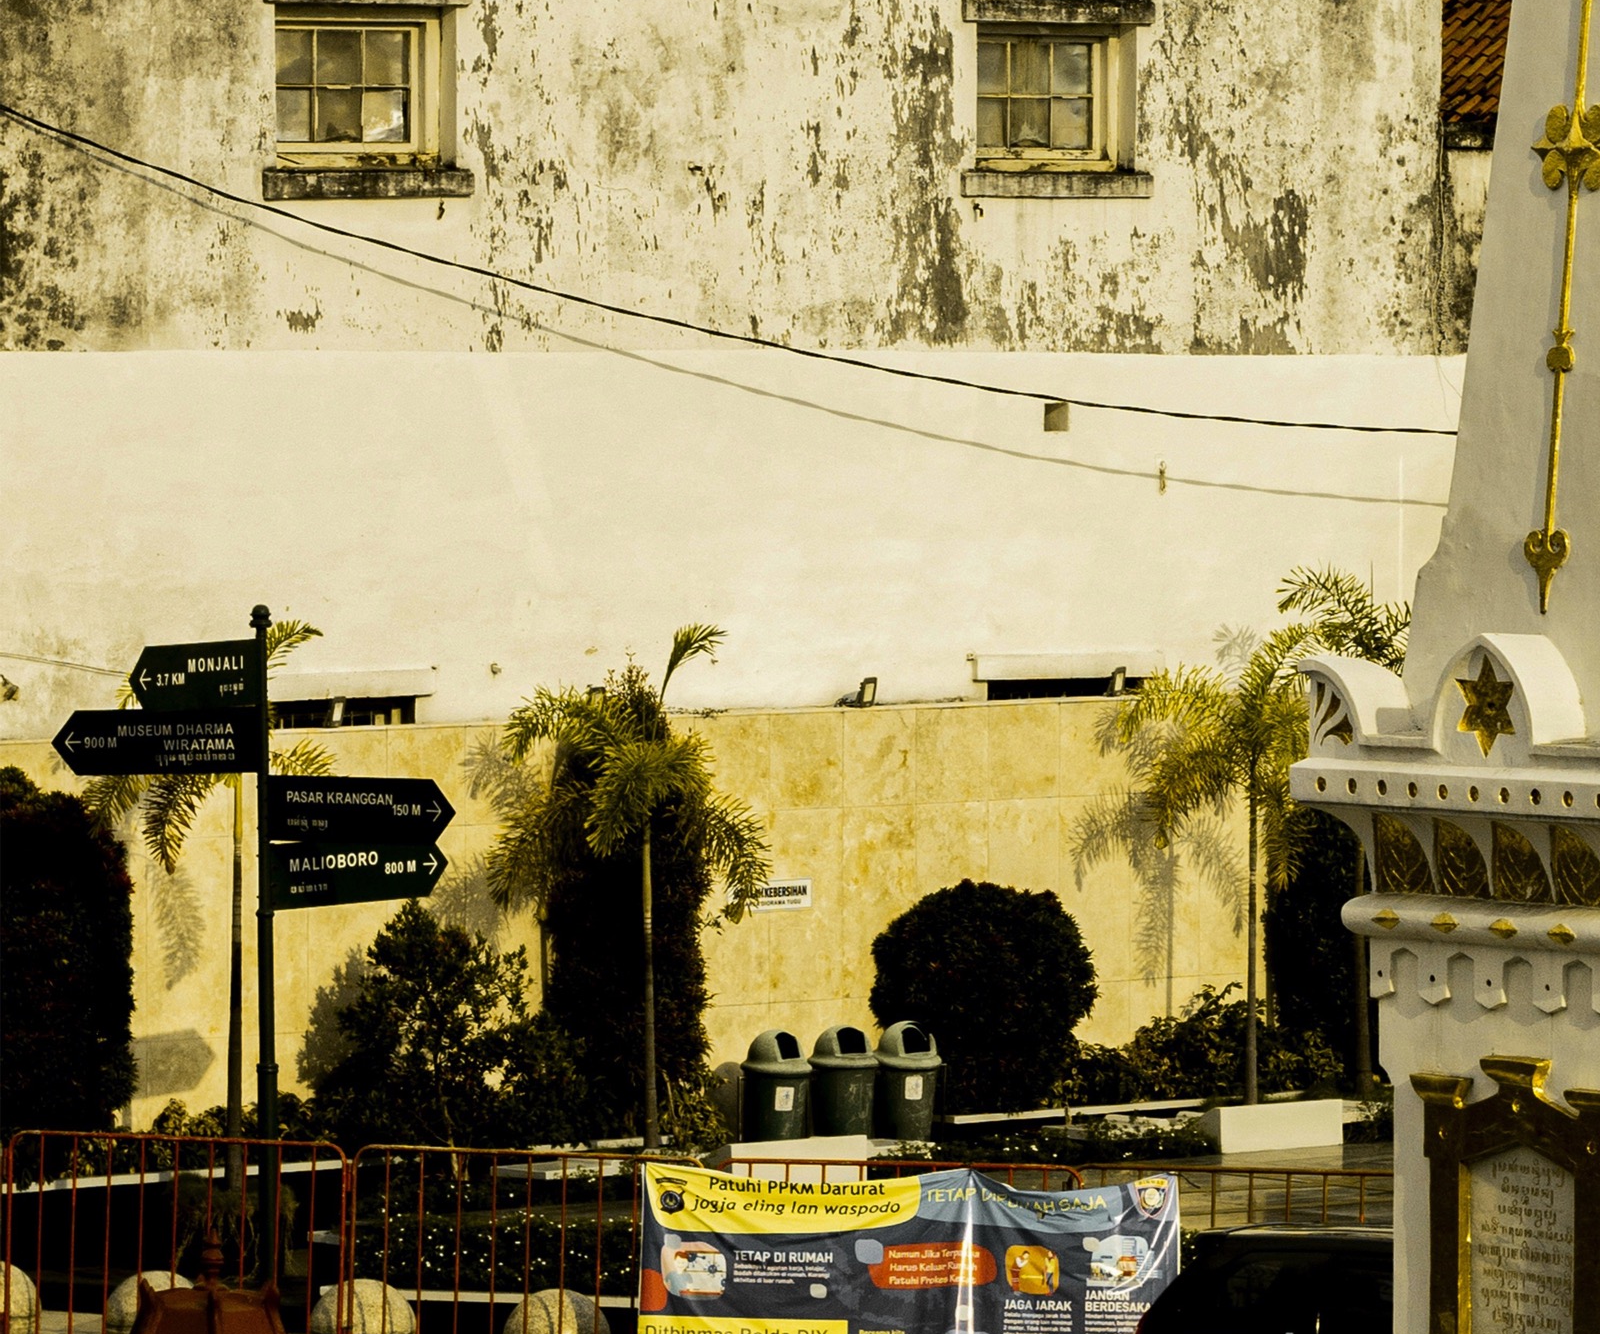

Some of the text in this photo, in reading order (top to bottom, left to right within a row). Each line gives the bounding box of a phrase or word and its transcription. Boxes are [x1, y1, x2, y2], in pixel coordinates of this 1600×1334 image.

[187, 655, 244, 673] MONJALI
[156, 672, 185, 686] 3.7 KM
[117, 723, 234, 737] MUSEUM DHARMA
[84, 736, 117, 749] 900 M
[163, 738, 235, 751] WIRATAMA
[286, 791, 393, 806] PASAR KRANGGAN
[393, 804, 421, 816] 150 M
[289, 851, 378, 872] MALIOBORO
[385, 860, 416, 875] 800 M
[764, 885, 808, 898] KEBERSIHAN
[709, 1176, 885, 1196] Patuhi PPKM Darurat
[927, 1186, 977, 1202] TETAP
[1059, 1195, 1107, 1211] SAJA
[691, 1195, 901, 1217] jogja eling lan waspodo
[733, 1250, 834, 1264] TETAP DI RUMAH
[889, 1249, 920, 1259] Namun
[921, 1249, 940, 1259] Jika
[889, 1262, 918, 1272] Harus
[919, 1262, 947, 1272] Keluar
[889, 1275, 919, 1285] Patuhi
[920, 1275, 948, 1285] Prokes
[1085, 1289, 1130, 1301] JANGAN
[1003, 1298, 1072, 1312] JAGA JARAK
